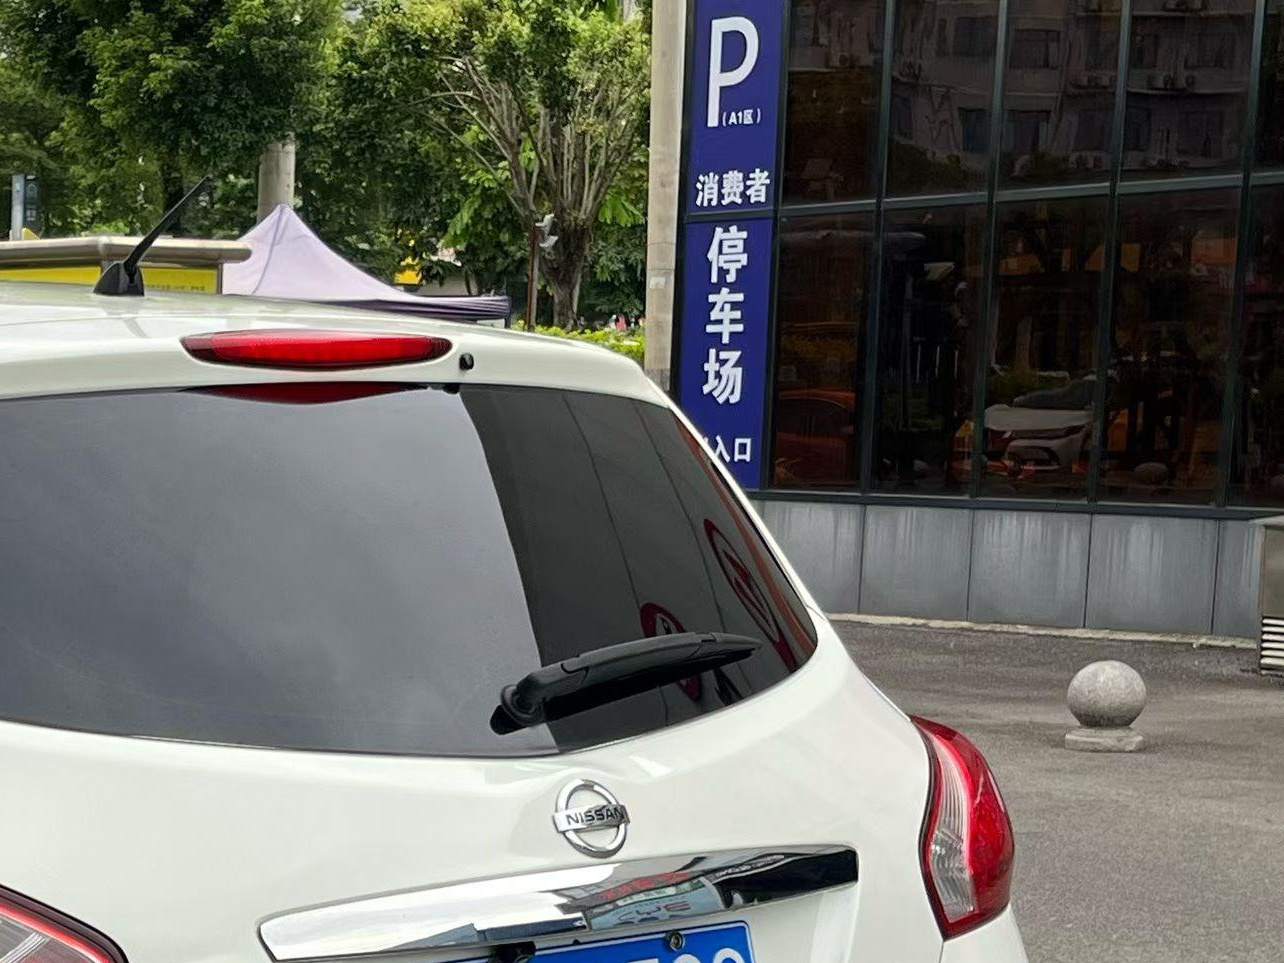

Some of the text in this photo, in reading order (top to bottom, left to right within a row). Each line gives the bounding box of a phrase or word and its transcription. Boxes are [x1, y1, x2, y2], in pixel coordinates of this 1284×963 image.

[707, 16, 759, 128] P
[695, 168, 770, 207] 消费者
[702, 225, 748, 404] 停车场
[565, 806, 625, 826] NISSAN
